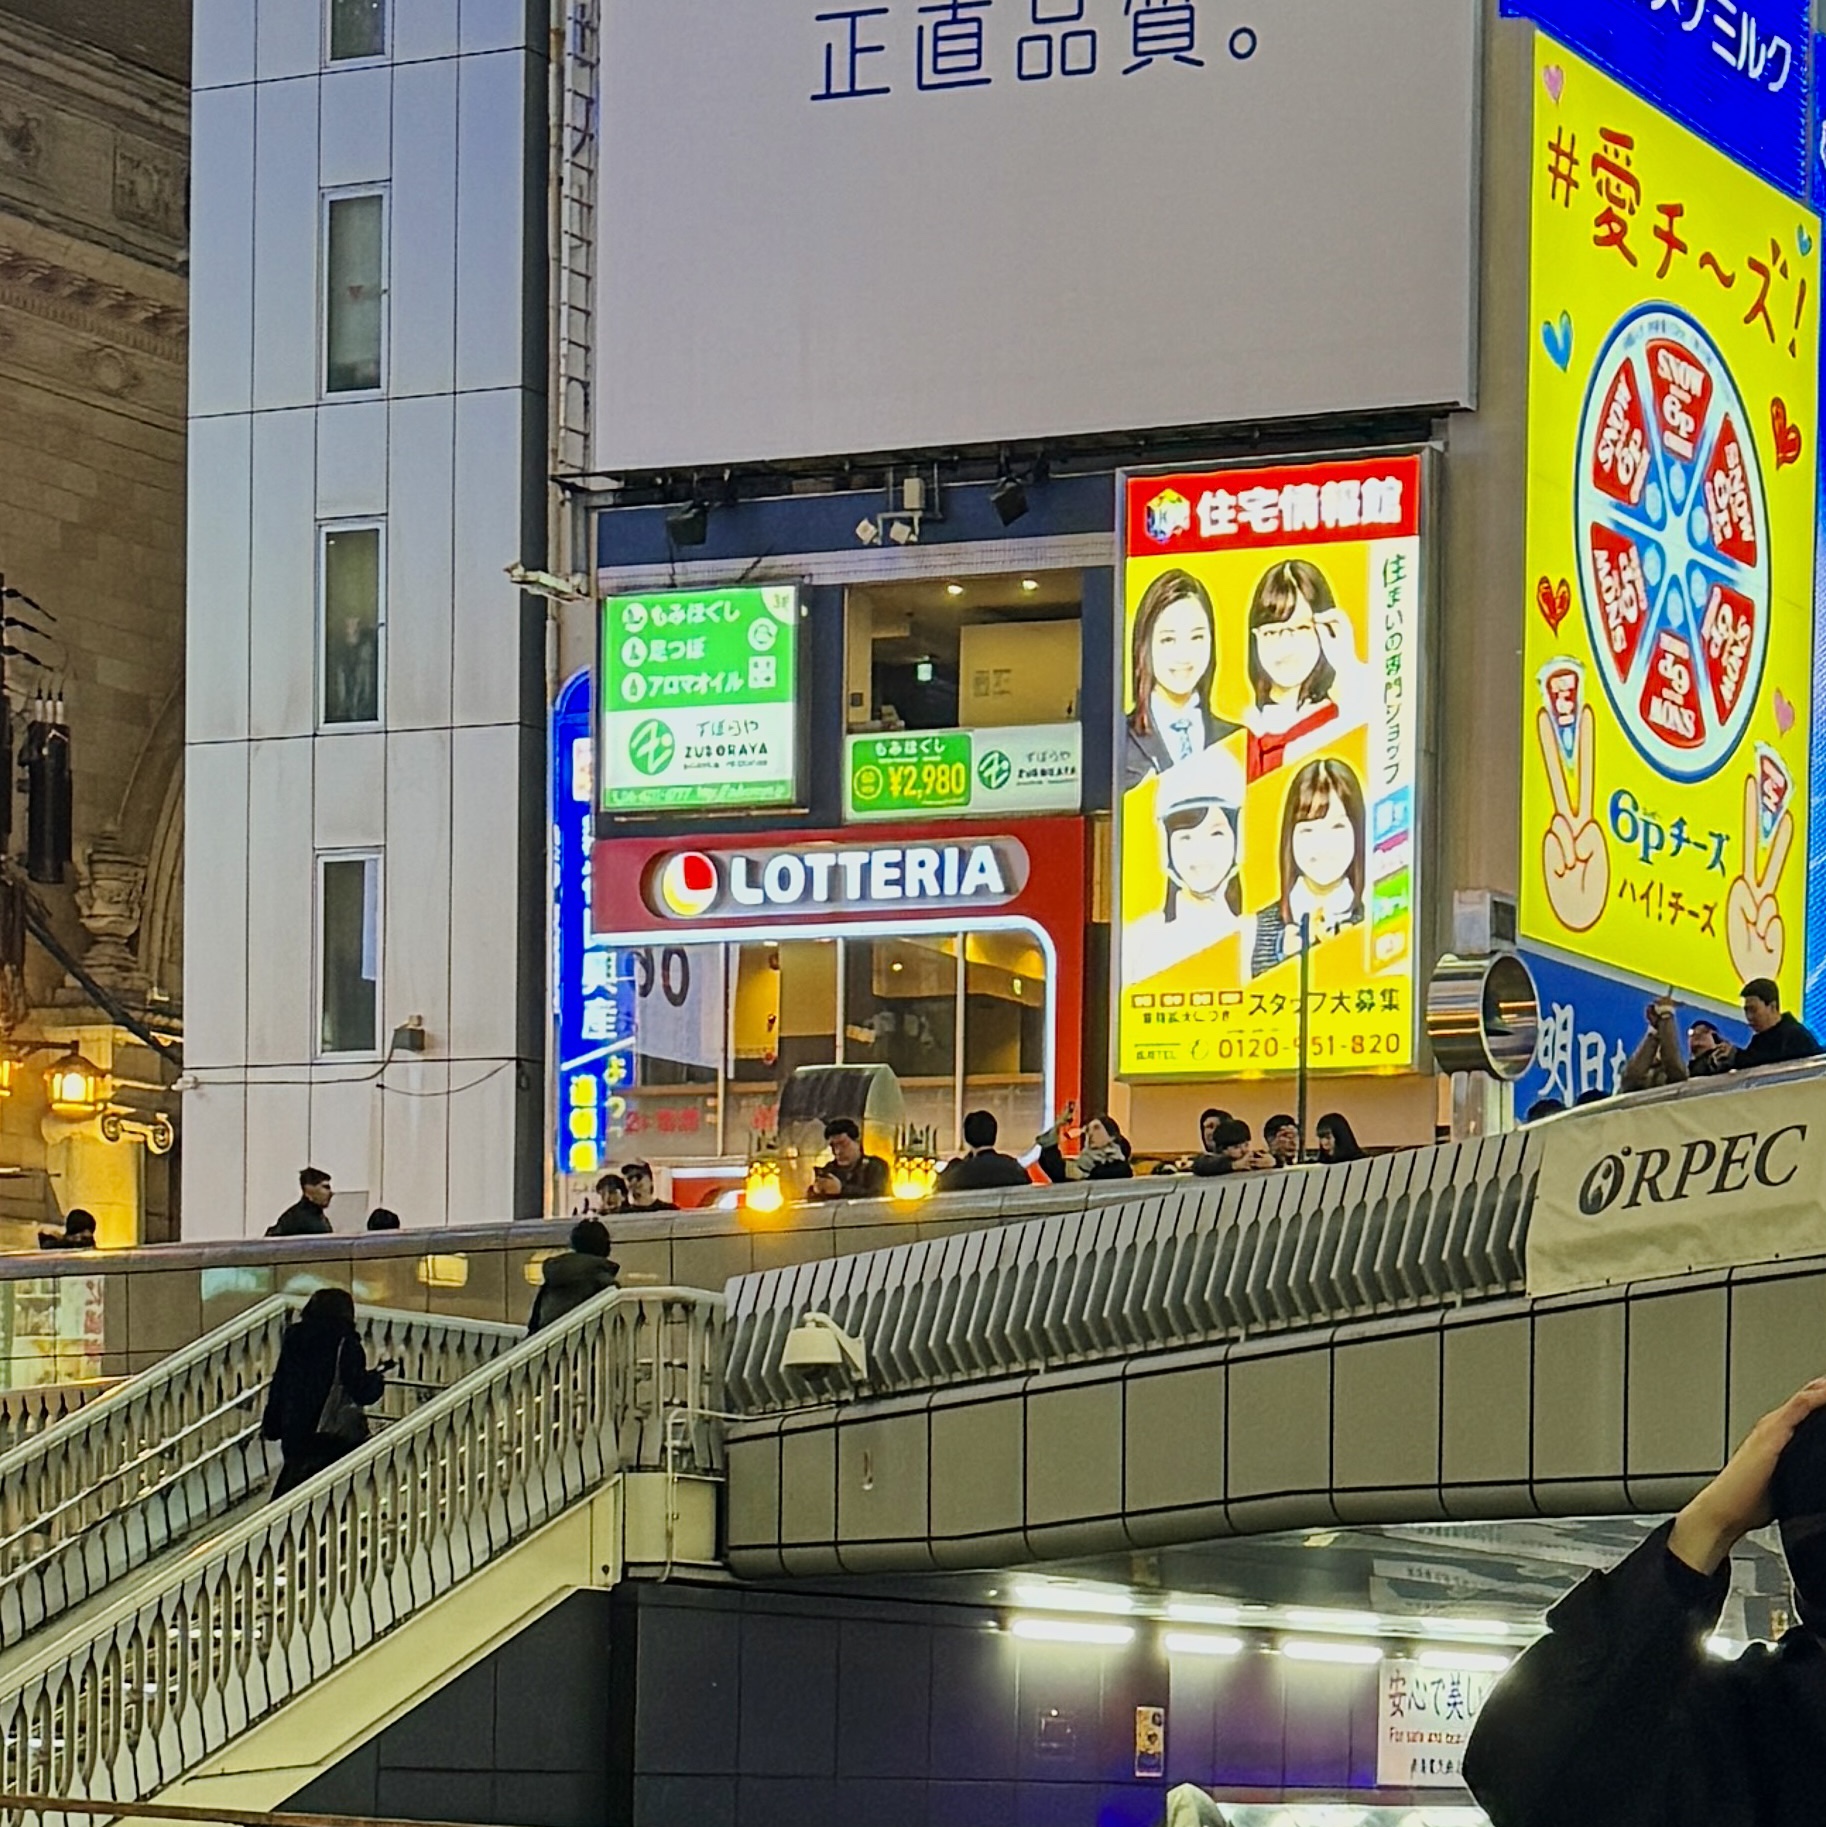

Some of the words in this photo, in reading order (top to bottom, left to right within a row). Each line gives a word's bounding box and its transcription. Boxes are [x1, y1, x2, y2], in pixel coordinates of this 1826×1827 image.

[1196, 476, 1403, 537] 住宅情報館
[647, 670, 744, 697] アロマオイル
[1383, 553, 1407, 784] 住まいの専門ショップ
[684, 742, 768, 760] ZUBORAYA
[888, 761, 966, 800] ¥2,980
[730, 844, 1005, 905] LOTTERIA
